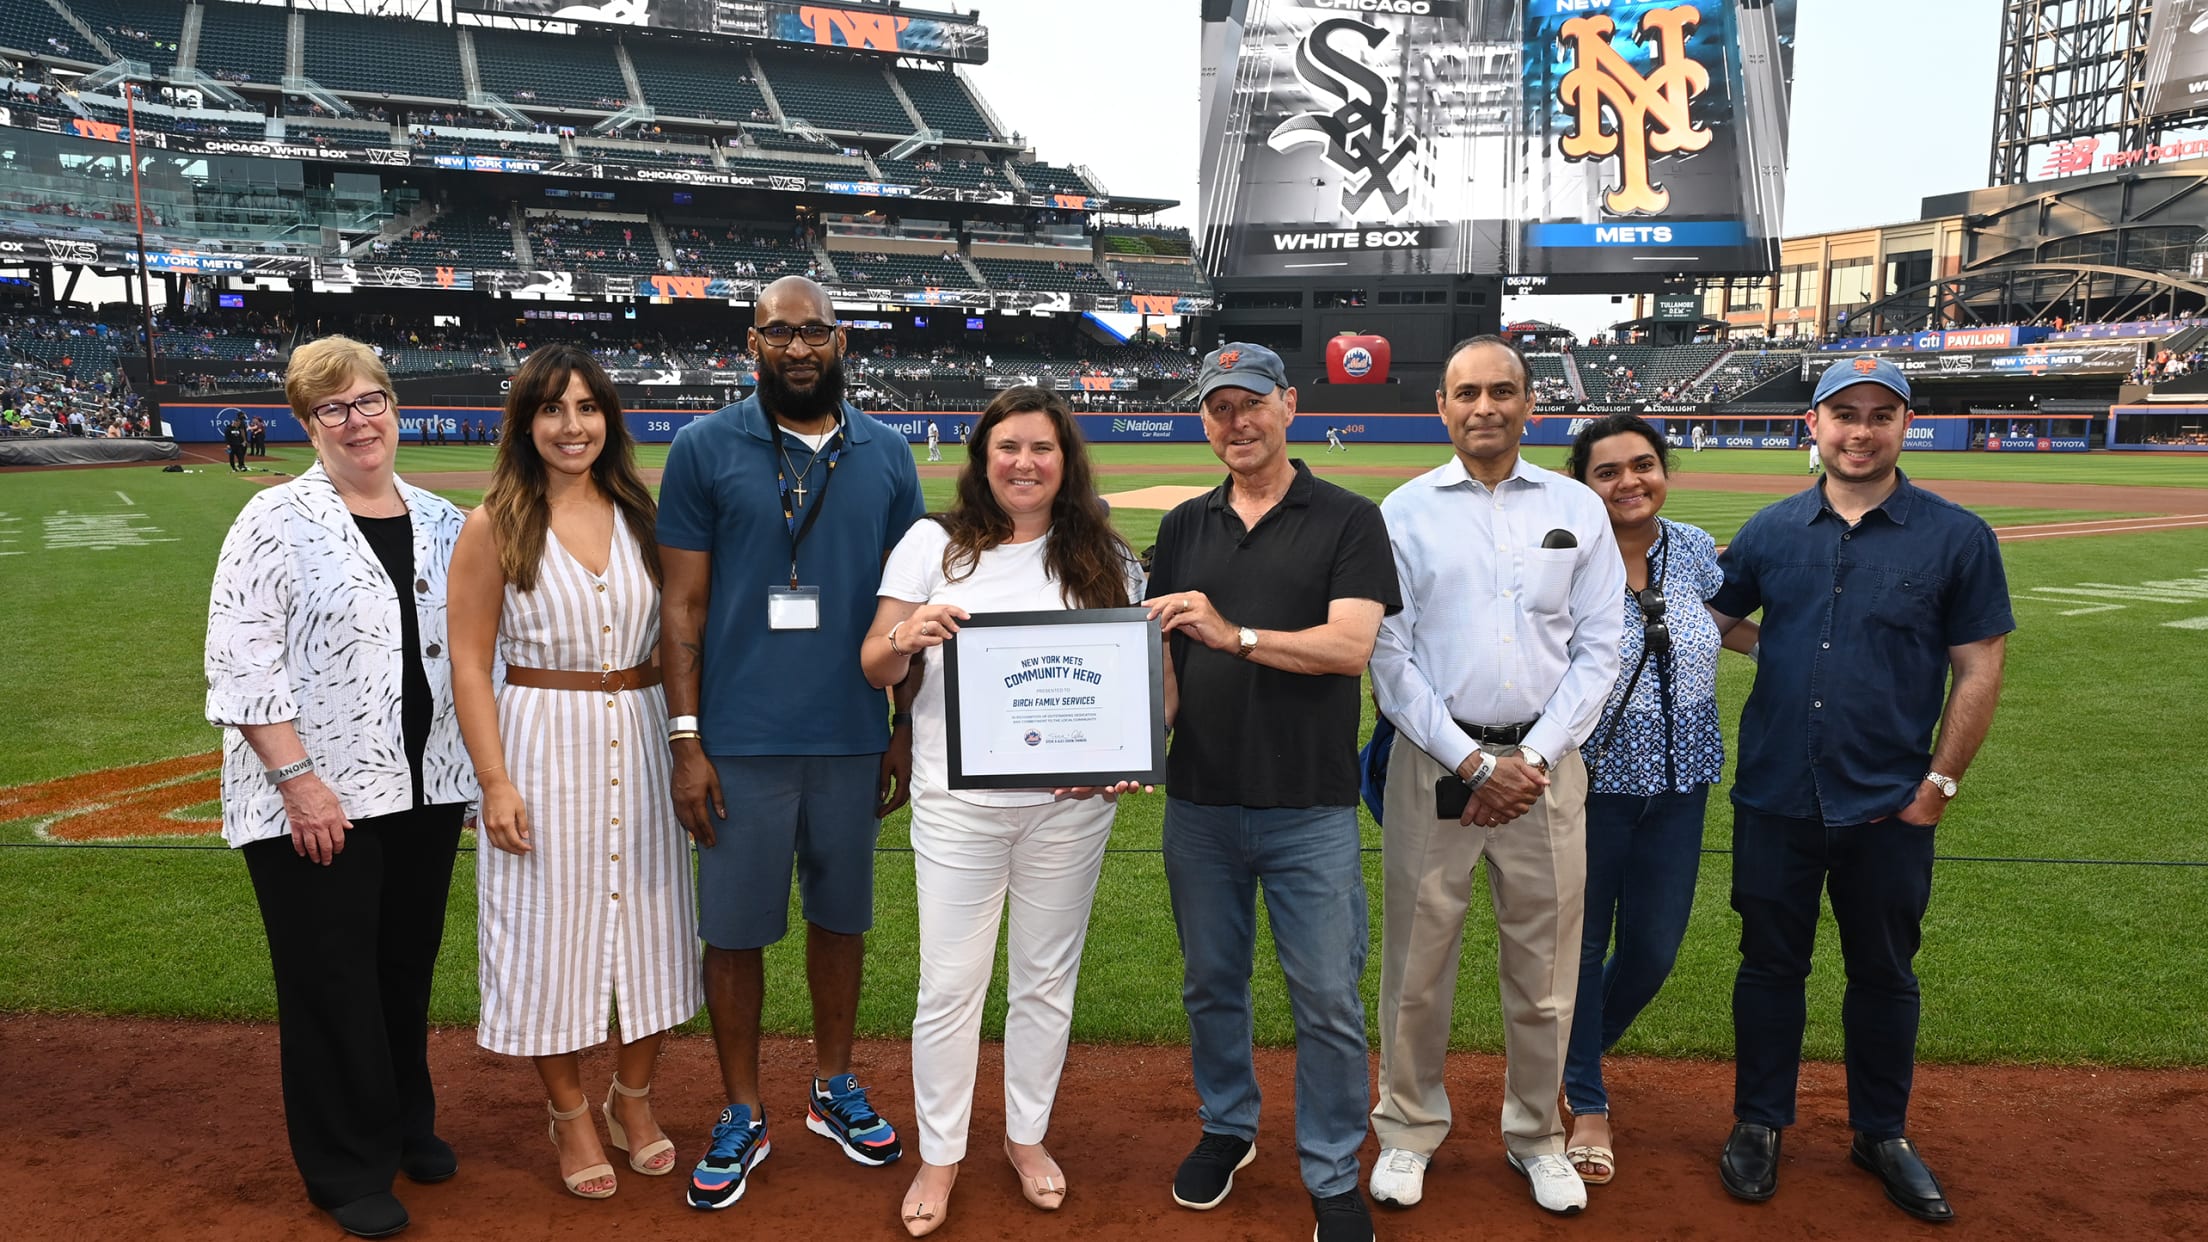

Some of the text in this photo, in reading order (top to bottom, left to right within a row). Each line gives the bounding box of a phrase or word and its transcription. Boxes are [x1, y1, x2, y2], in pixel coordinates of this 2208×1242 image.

[1315, 0, 1430, 15] CHICAGO
[205, 141, 270, 154] CHICAGO
[273, 146, 317, 157] WHITE
[2103, 139, 2208, 167] new balan
[365, 148, 410, 166] VS
[434, 156, 540, 171] NEW YORK METS
[637, 170, 691, 182] CHICAGO
[693, 174, 728, 184] WHITE
[825, 182, 911, 196] NEW YORK METS
[1273, 231, 1420, 250] WHITE SOX
[1596, 226, 1672, 243] METS
[0, 241, 24, 252] OX
[162, 255, 199, 267] YORK
[202, 258, 245, 269] METS
[1507, 277, 1547, 286] 06:47 PM
[1947, 333, 2005, 346] PAVILION
[1991, 355, 2083, 366] NEW YORK METS
[648, 421, 670, 431] 358
[1126, 419, 1173, 431] National
[1345, 424, 1365, 432] 408
[1726, 437, 1753, 446] GOYA
[1761, 438, 1790, 447] GOYA
[2001, 440, 2035, 448] TOYOTA
[2051, 440, 2085, 448] TOYOTA
[1021, 655, 1084, 668] NEW YORK METS
[1004, 666, 1102, 688] COMMUNITY HERO
[1012, 696, 1095, 707] BIRCH FAMILY SERVICES
